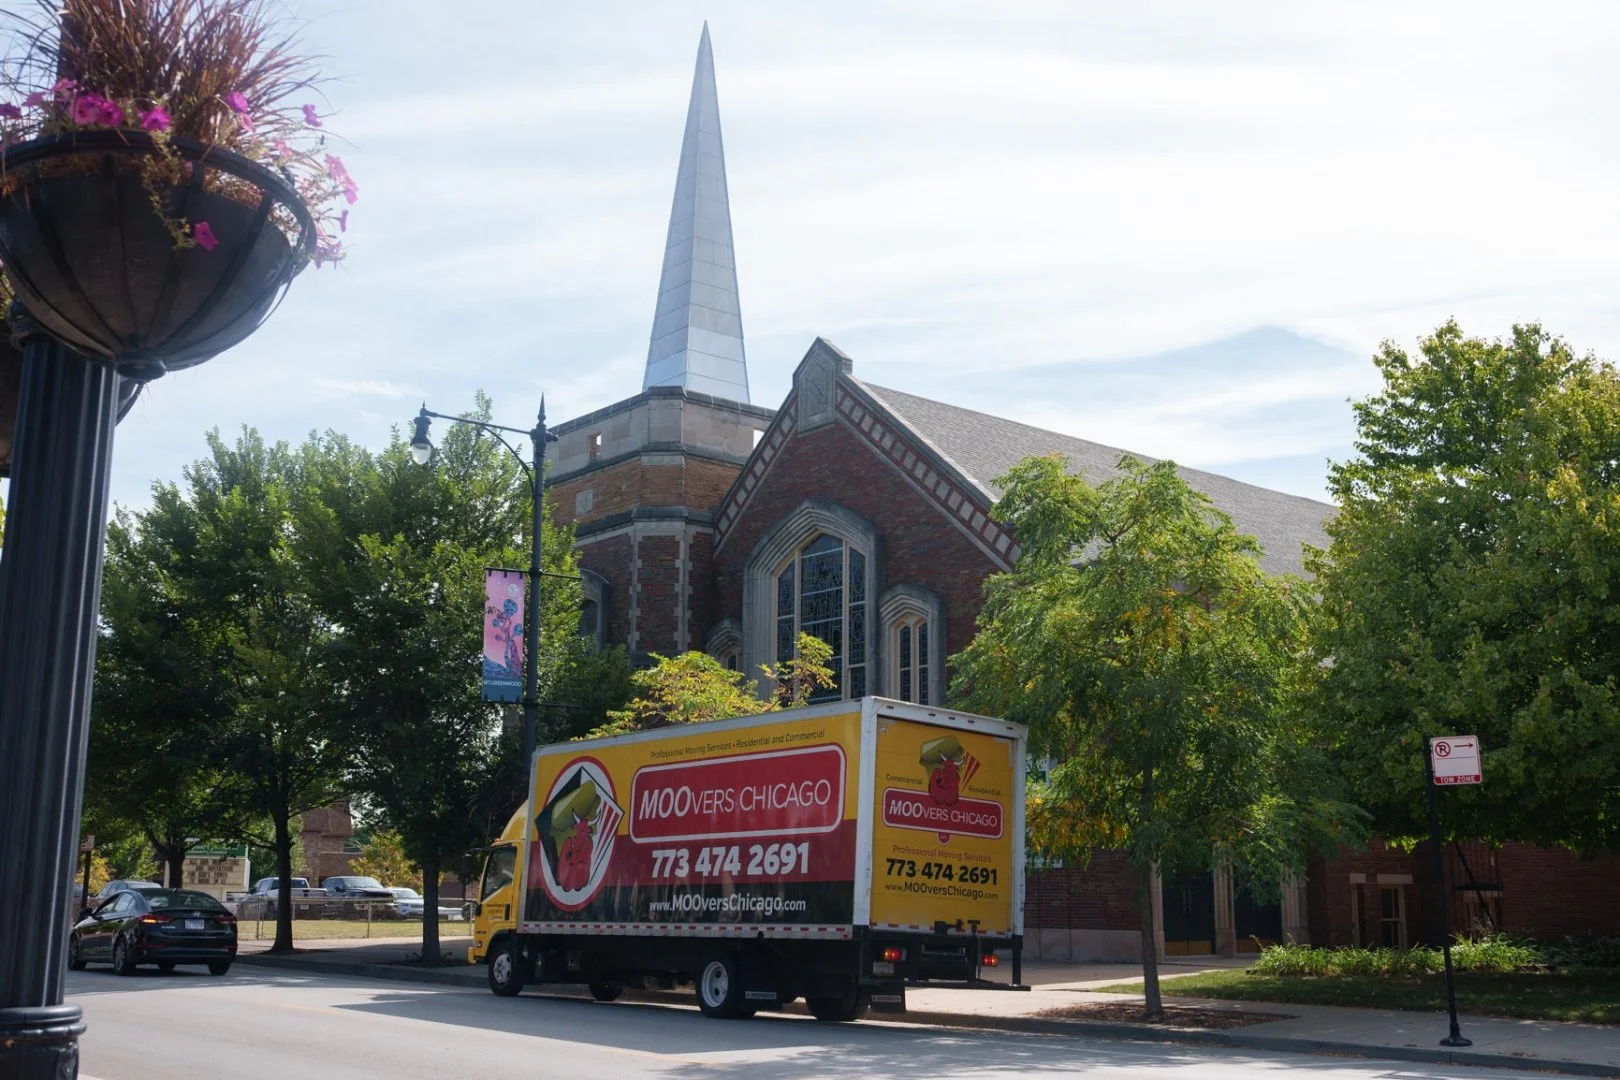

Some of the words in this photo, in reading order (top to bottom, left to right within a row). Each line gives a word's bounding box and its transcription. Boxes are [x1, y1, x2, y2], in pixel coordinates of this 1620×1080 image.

[650, 749, 685, 759] Professional
[685, 746, 706, 756] Moving
[706, 743, 731, 752] Services
[736, 737, 771, 748] Residential
[772, 735, 784, 745] and
[785, 729, 825, 743] Commercial
[886, 773, 924, 785] Commercial
[1457, 775, 1475, 783] ZONE
[739, 779, 831, 811] CHICAGO
[968, 785, 1002, 797] Residential
[950, 810, 998, 827] CHICAGO
[651, 848, 690, 878] 773
[694, 845, 741, 877] 474
[746, 842, 810, 876] 2691
[893, 844, 936, 857] Professional
[937, 848, 962, 861] Moving
[963, 852, 992, 863] Services
[884, 881, 999, 900] www.MOOversChicago.com
[649, 893, 806, 915] www.MOOversChicago.com
